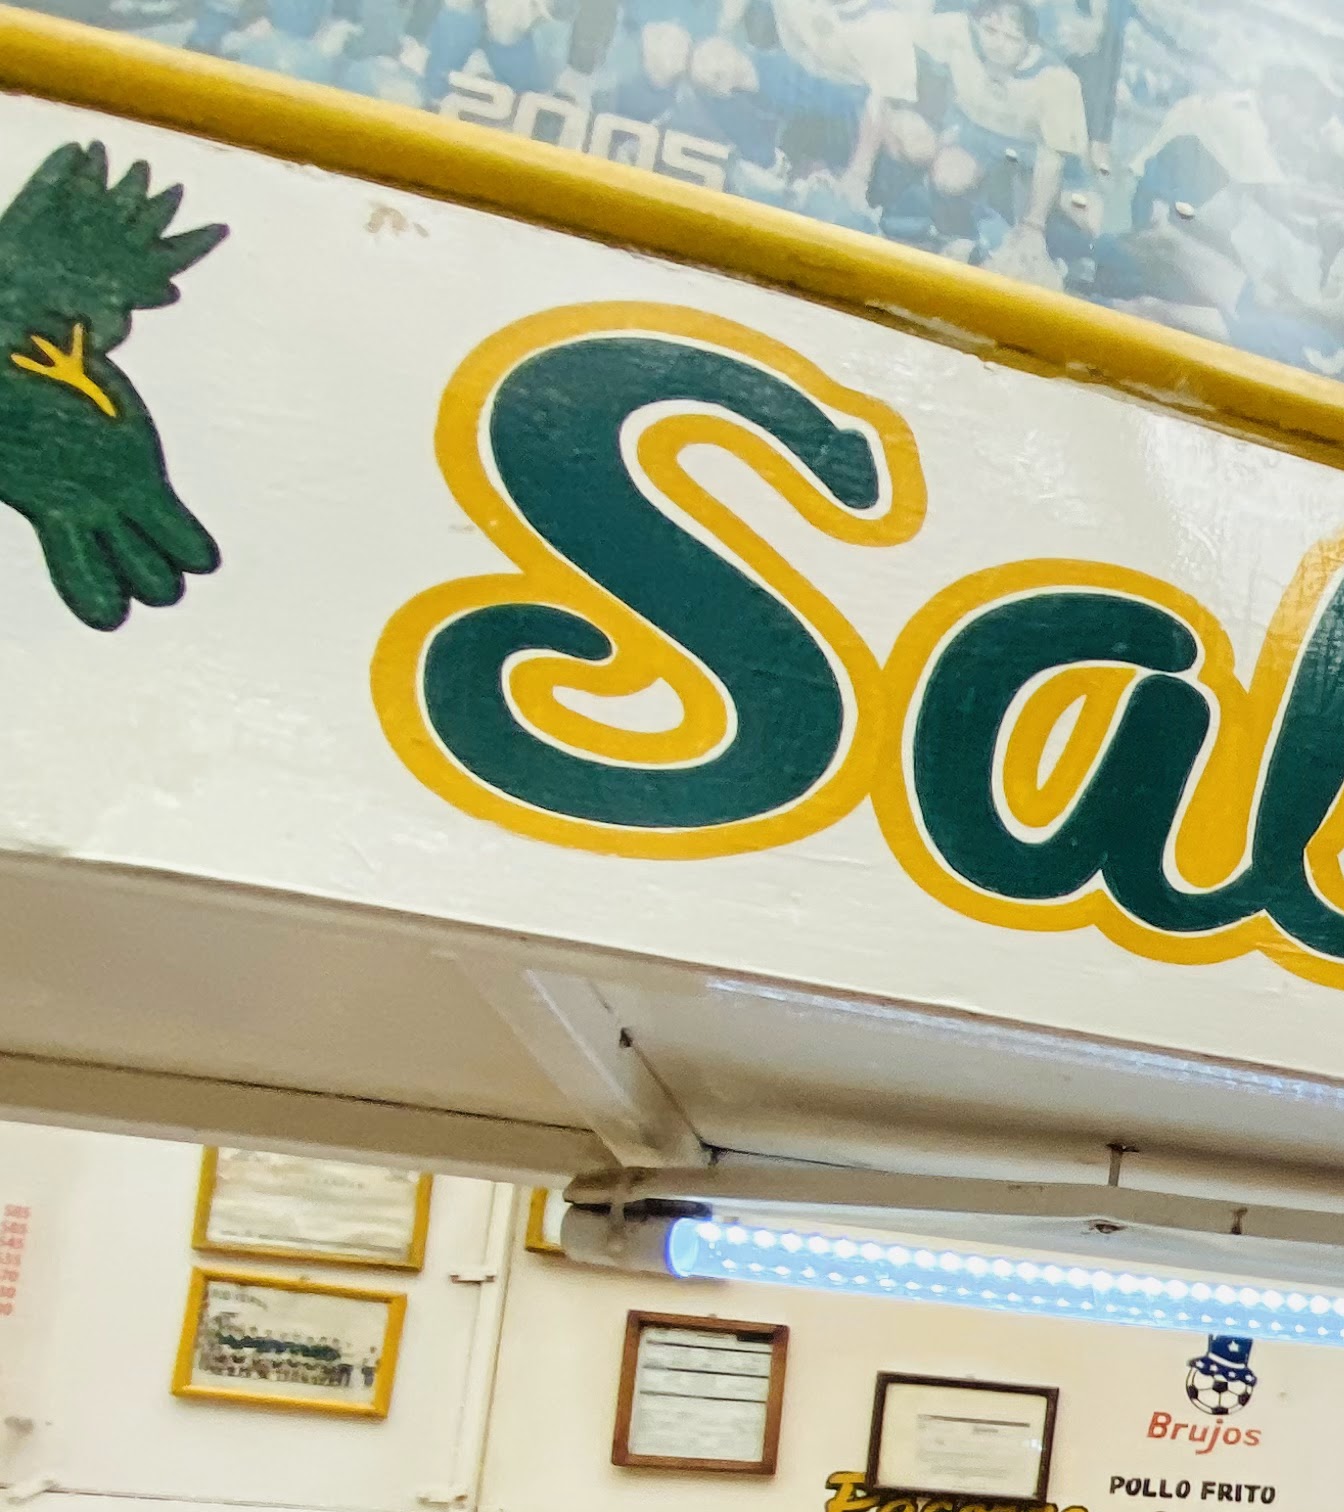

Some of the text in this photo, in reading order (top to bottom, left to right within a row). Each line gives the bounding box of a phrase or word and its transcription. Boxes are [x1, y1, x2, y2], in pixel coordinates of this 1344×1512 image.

[1147, 1411, 1262, 1455] Brujos
[1109, 1475, 1276, 1504] POLLO FRITO
